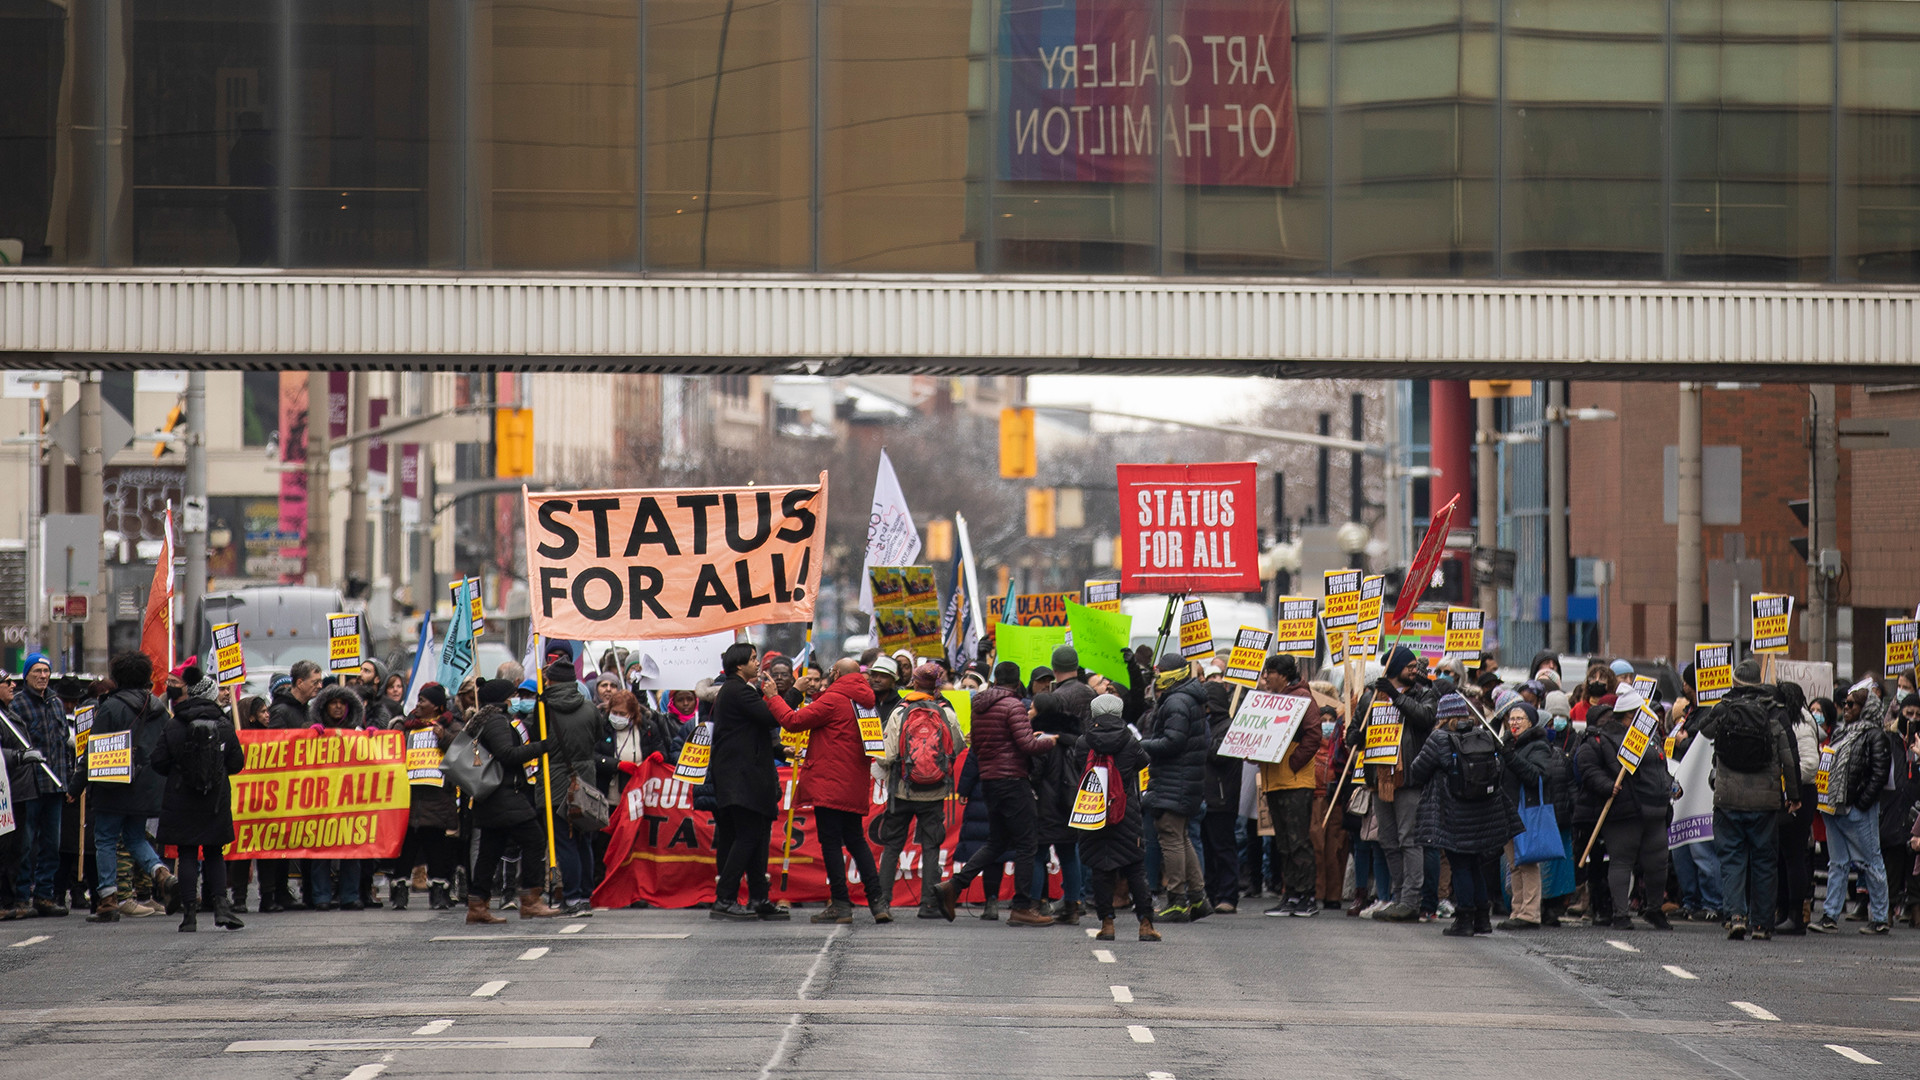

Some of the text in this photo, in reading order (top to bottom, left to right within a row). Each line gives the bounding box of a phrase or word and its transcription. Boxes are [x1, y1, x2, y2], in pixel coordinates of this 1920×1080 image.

[1138, 489, 1235, 527] STATUS
[537, 489, 819, 560] STATUS
[1140, 530, 1236, 567] FOR ALL
[539, 566, 673, 621] FOR
[687, 546, 810, 618] ALL!
[1328, 594, 1359, 606] STATUS
[1361, 600, 1379, 611] STATUS
[1328, 603, 1359, 614] FOR ALL
[1360, 608, 1379, 620] FOR ALL
[1284, 609, 1313, 620] EVERYONE
[1281, 622, 1313, 632] STATUS
[1756, 617, 1785, 628] STATUS
[1195, 630, 1210, 641] ALL
[1280, 629, 1313, 641] FOR ALL
[1450, 632, 1480, 640] STATUS
[1756, 625, 1786, 637] FOR ALL
[332, 638, 357, 649] STATUS
[1279, 641, 1286, 651] NO
[1448, 641, 1464, 649] FOR
[218, 646, 239, 660] STATUS
[332, 646, 358, 658] FOR ALL
[1234, 649, 1263, 660] STATUS
[219, 654, 240, 669] FOR ALL
[1231, 657, 1261, 668] FOR ALL
[1889, 653, 1906, 663] FOR
[1700, 668, 1730, 679] STATUS
[1699, 676, 1730, 688] FOR ALL
[861, 720, 880, 730] STATUS
[1233, 713, 1273, 730] UNTUK
[862, 729, 882, 738] FOR ALL
[1630, 730, 1646, 746] STATUS
[1224, 731, 1262, 748] SEMUA
[294, 733, 401, 767] EVERYONE!
[1625, 738, 1644, 753] FOR ALL
[92, 751, 127, 761] STATUS
[92, 756, 127, 767] FOR ALL
[682, 754, 702, 765] FOR
[409, 758, 425, 769] FOR
[286, 776, 328, 811] FOR
[337, 770, 394, 807] ALL!
[1077, 802, 1096, 812] FOR
[237, 814, 378, 854] EXCLUSIONS!
